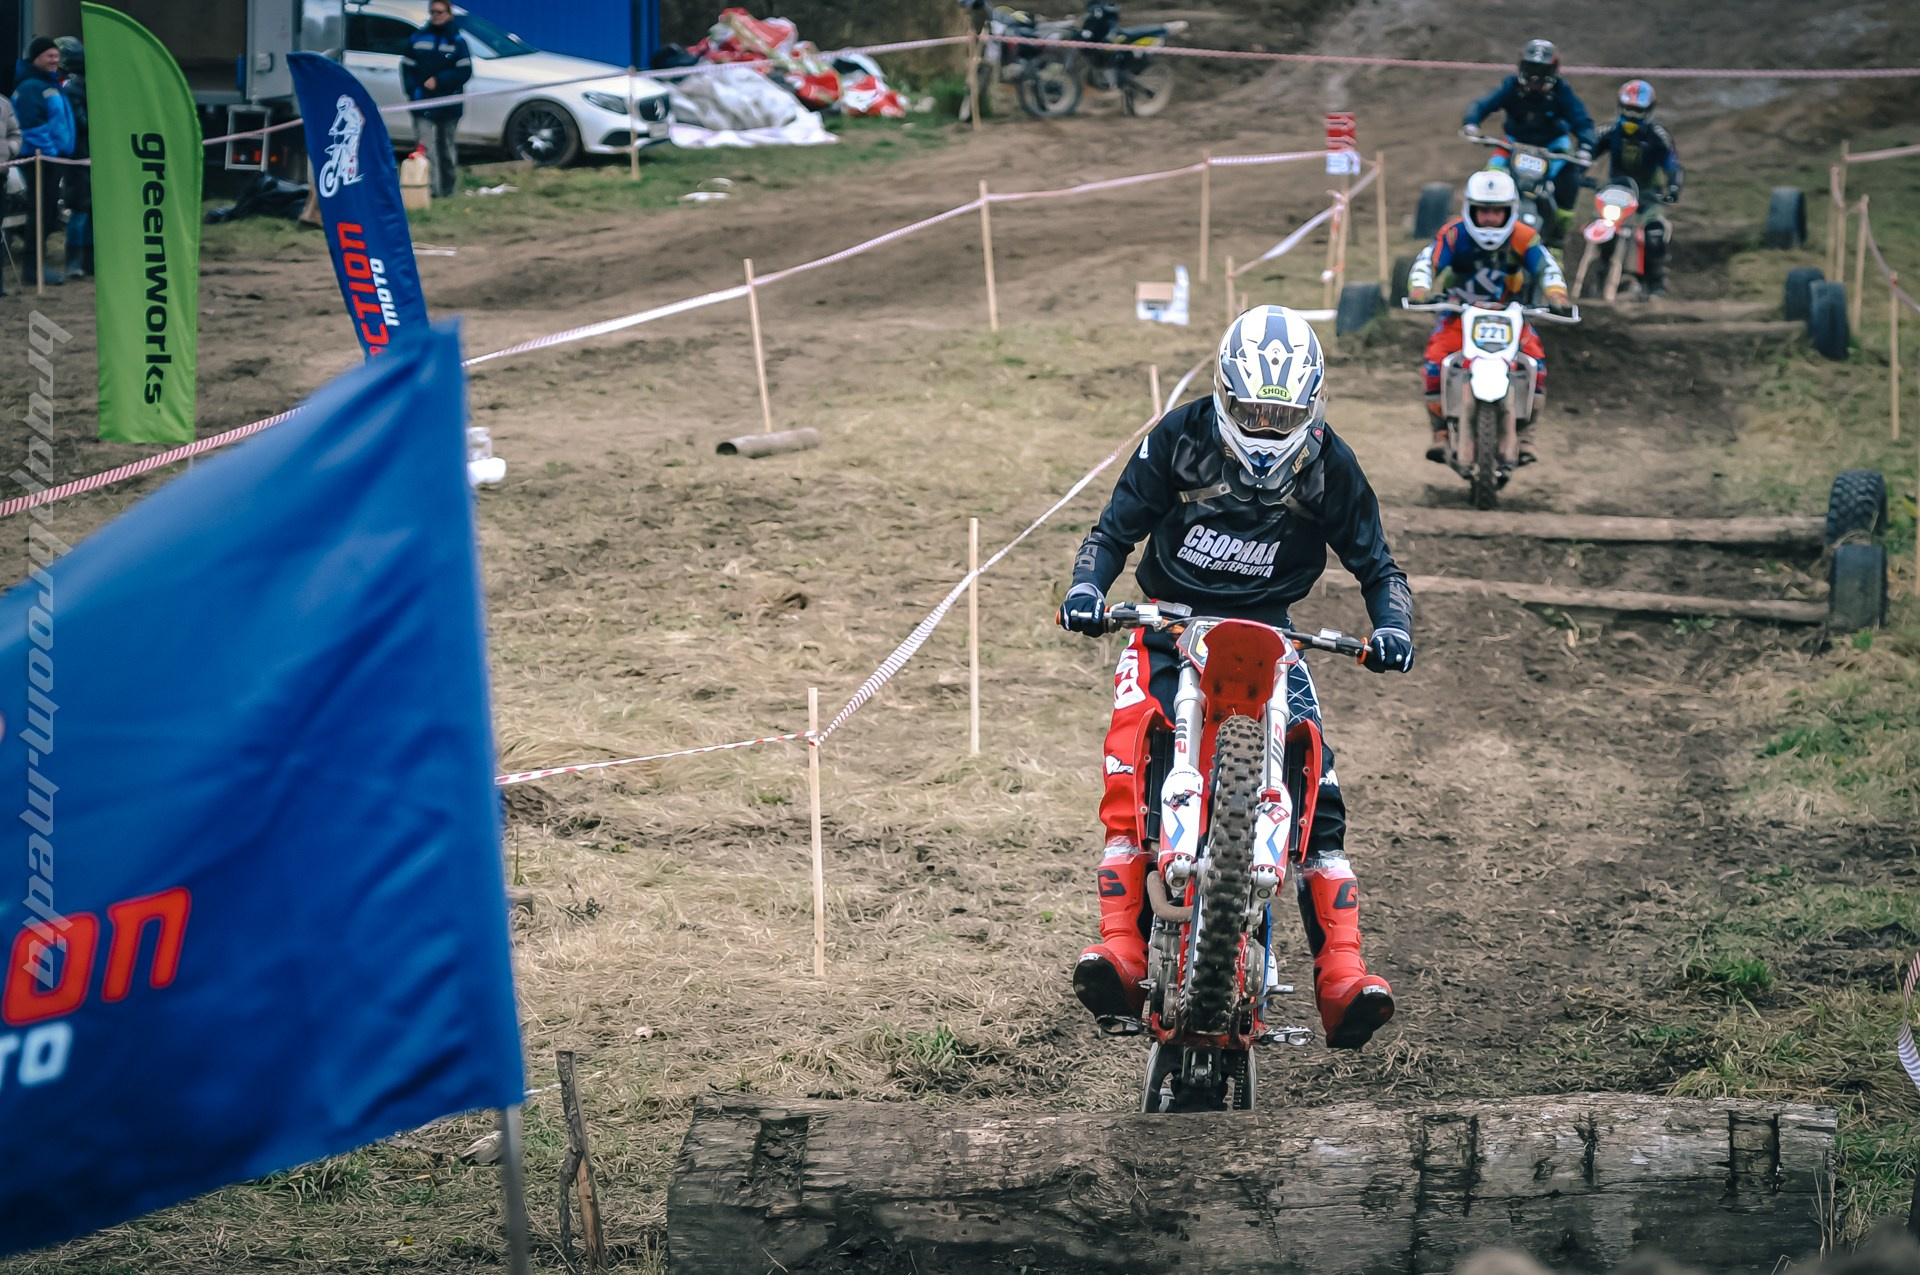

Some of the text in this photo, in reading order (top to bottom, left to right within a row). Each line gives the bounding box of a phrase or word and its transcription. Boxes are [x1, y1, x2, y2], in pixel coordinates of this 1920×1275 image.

[131, 132, 172, 405] greenworks
[1262, 387, 1288, 398] SHOEI
[1177, 546, 1275, 579] САНКТ-ПЕТЕРБУРГА
[1184, 524, 1281, 565] СБОРНАЯ
